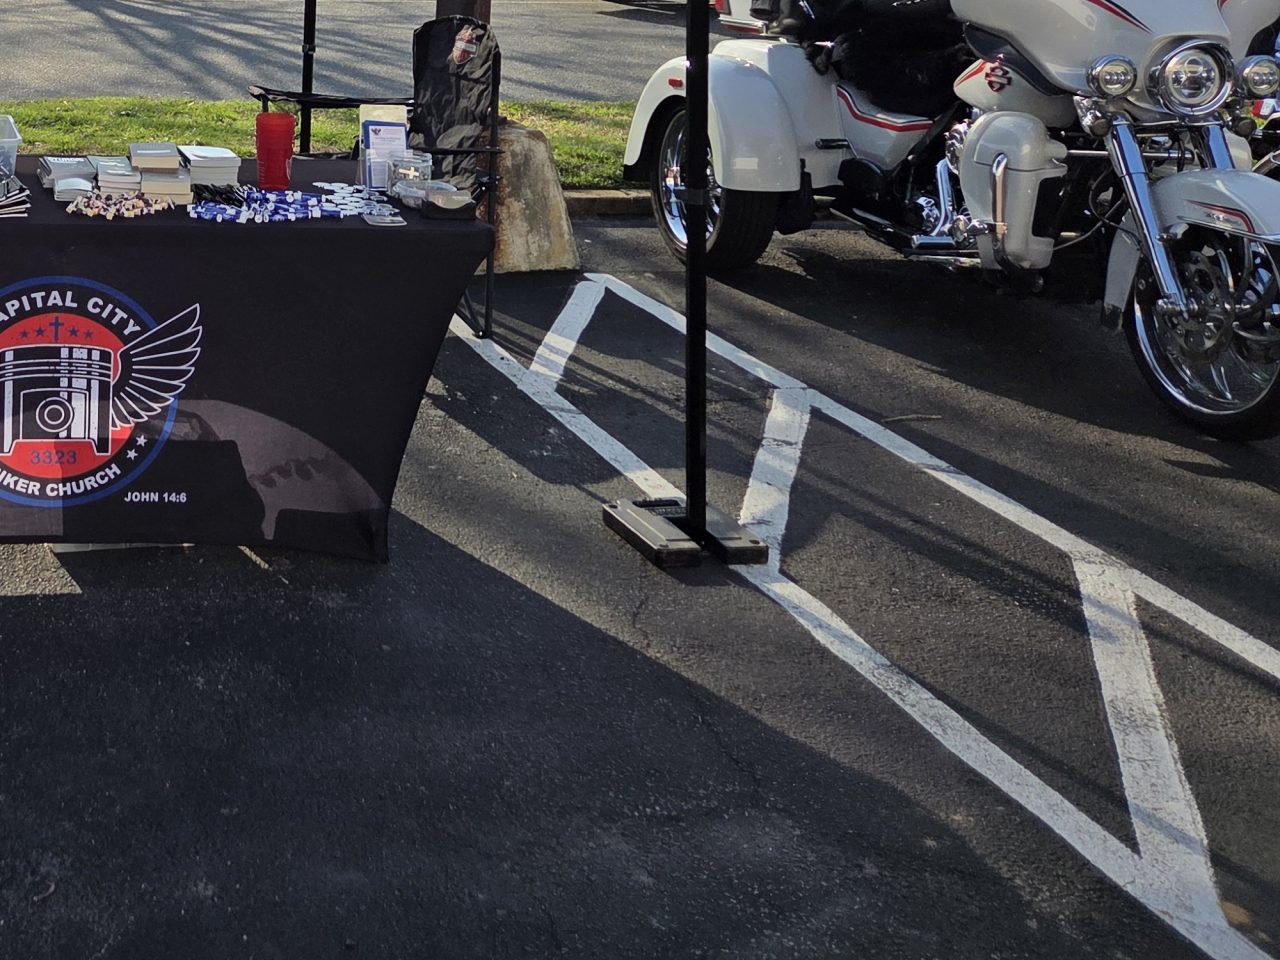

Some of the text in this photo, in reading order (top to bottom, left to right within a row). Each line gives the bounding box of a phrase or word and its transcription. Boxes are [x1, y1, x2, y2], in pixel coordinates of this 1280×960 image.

[86, 296, 142, 336] CITY
[31, 450, 78, 465] 3323
[45, 463, 121, 496] CHURCH
[124, 491, 187, 503] JOHN 14:6
